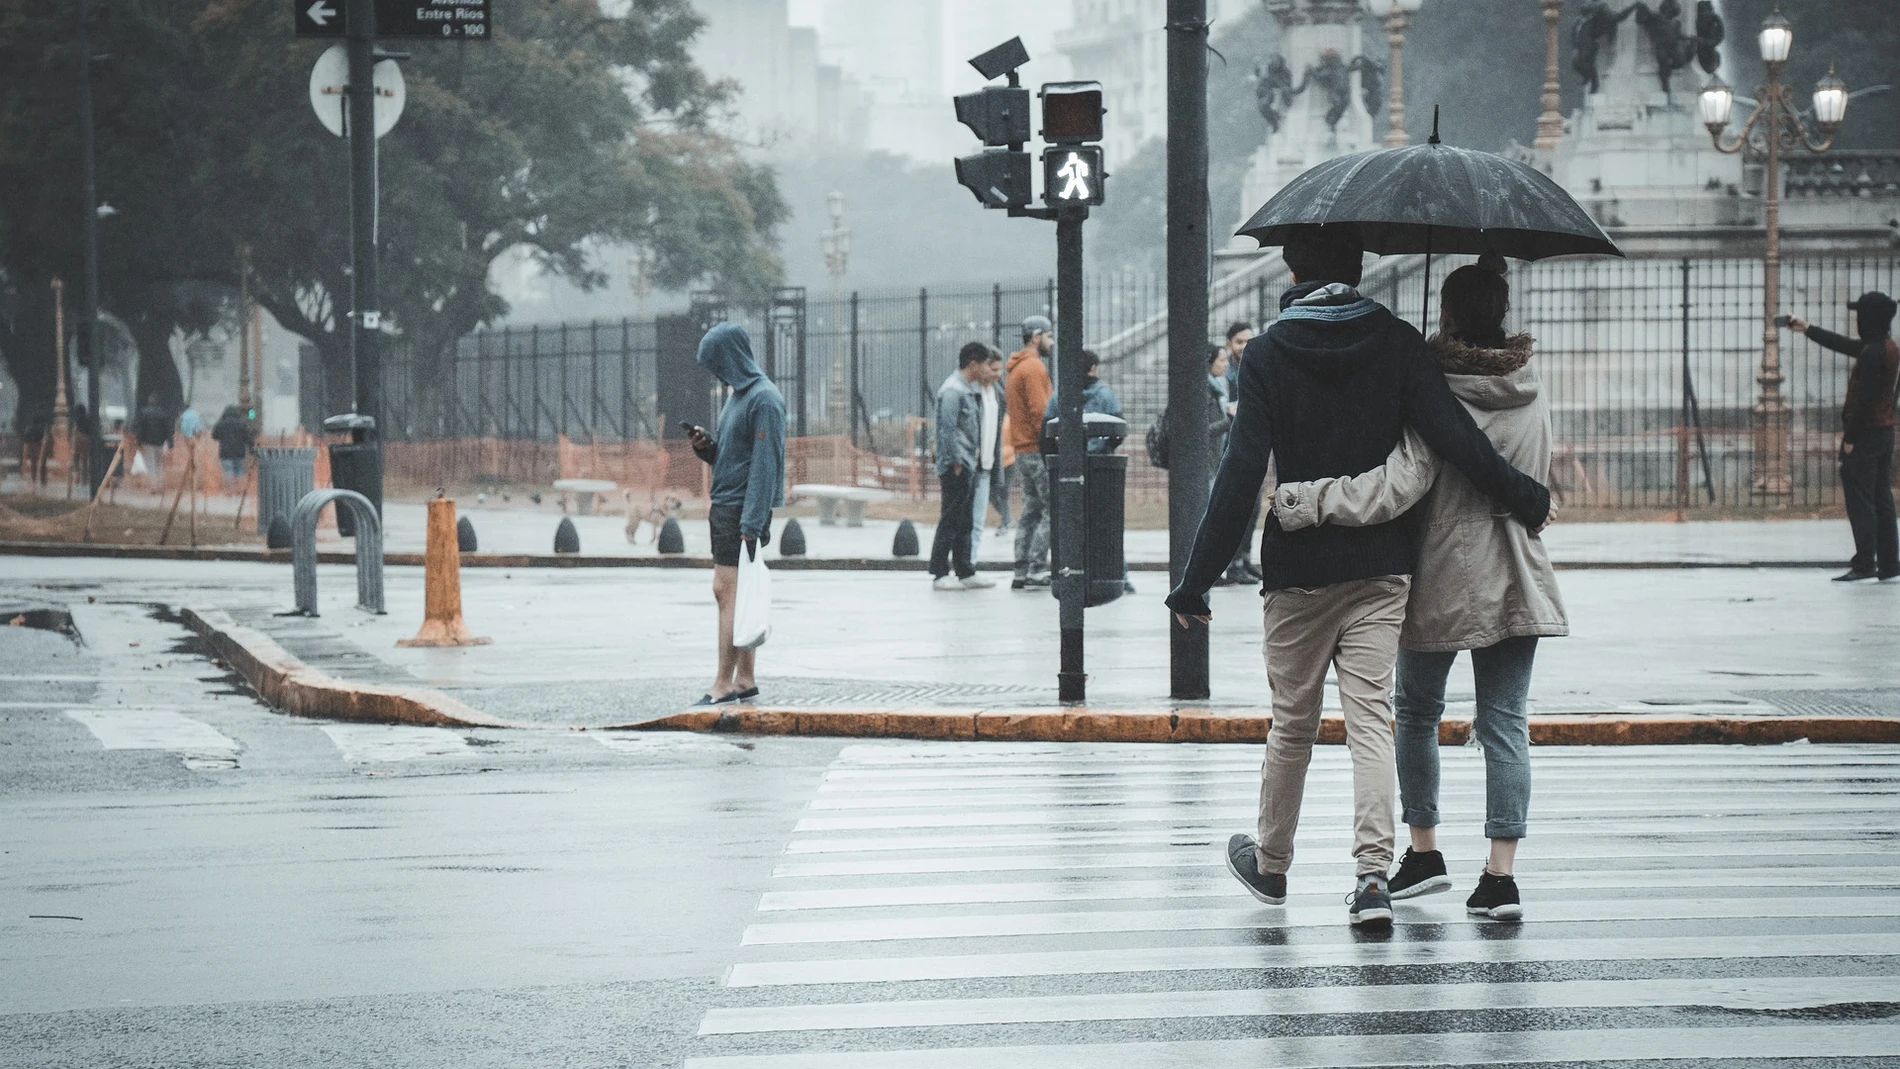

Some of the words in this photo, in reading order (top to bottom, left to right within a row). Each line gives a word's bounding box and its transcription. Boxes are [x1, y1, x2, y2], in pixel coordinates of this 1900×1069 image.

[416, 7, 452, 19] Entre
[442, 23, 451, 36] 0
[463, 23, 485, 35] 100
